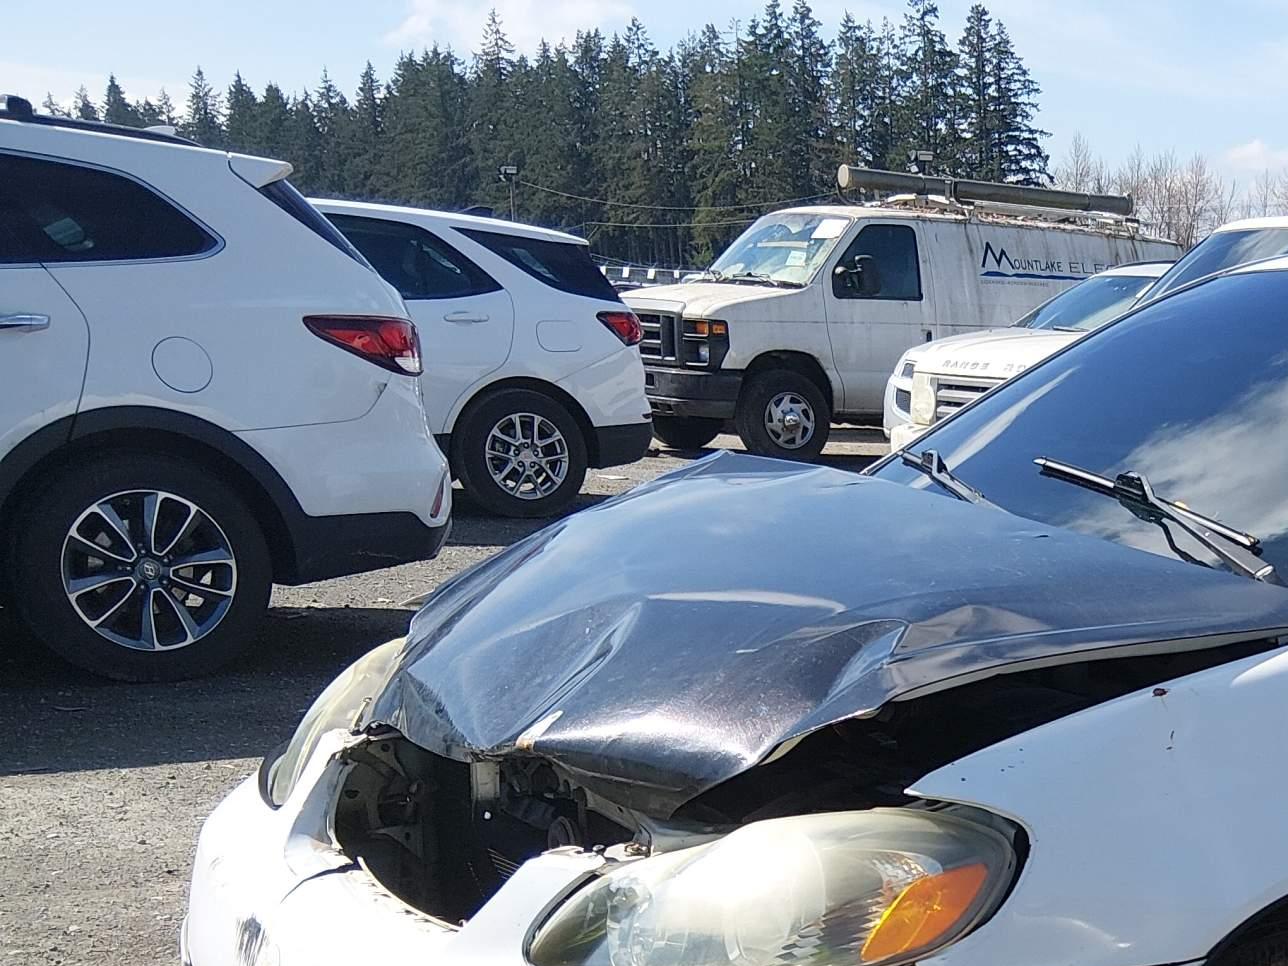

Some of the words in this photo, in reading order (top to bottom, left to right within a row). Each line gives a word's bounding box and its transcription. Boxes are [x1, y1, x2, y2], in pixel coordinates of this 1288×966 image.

[981, 241, 1063, 272] MOUNTLAKE
[942, 360, 990, 370] RANGE
[1003, 363, 1027, 372] RO
